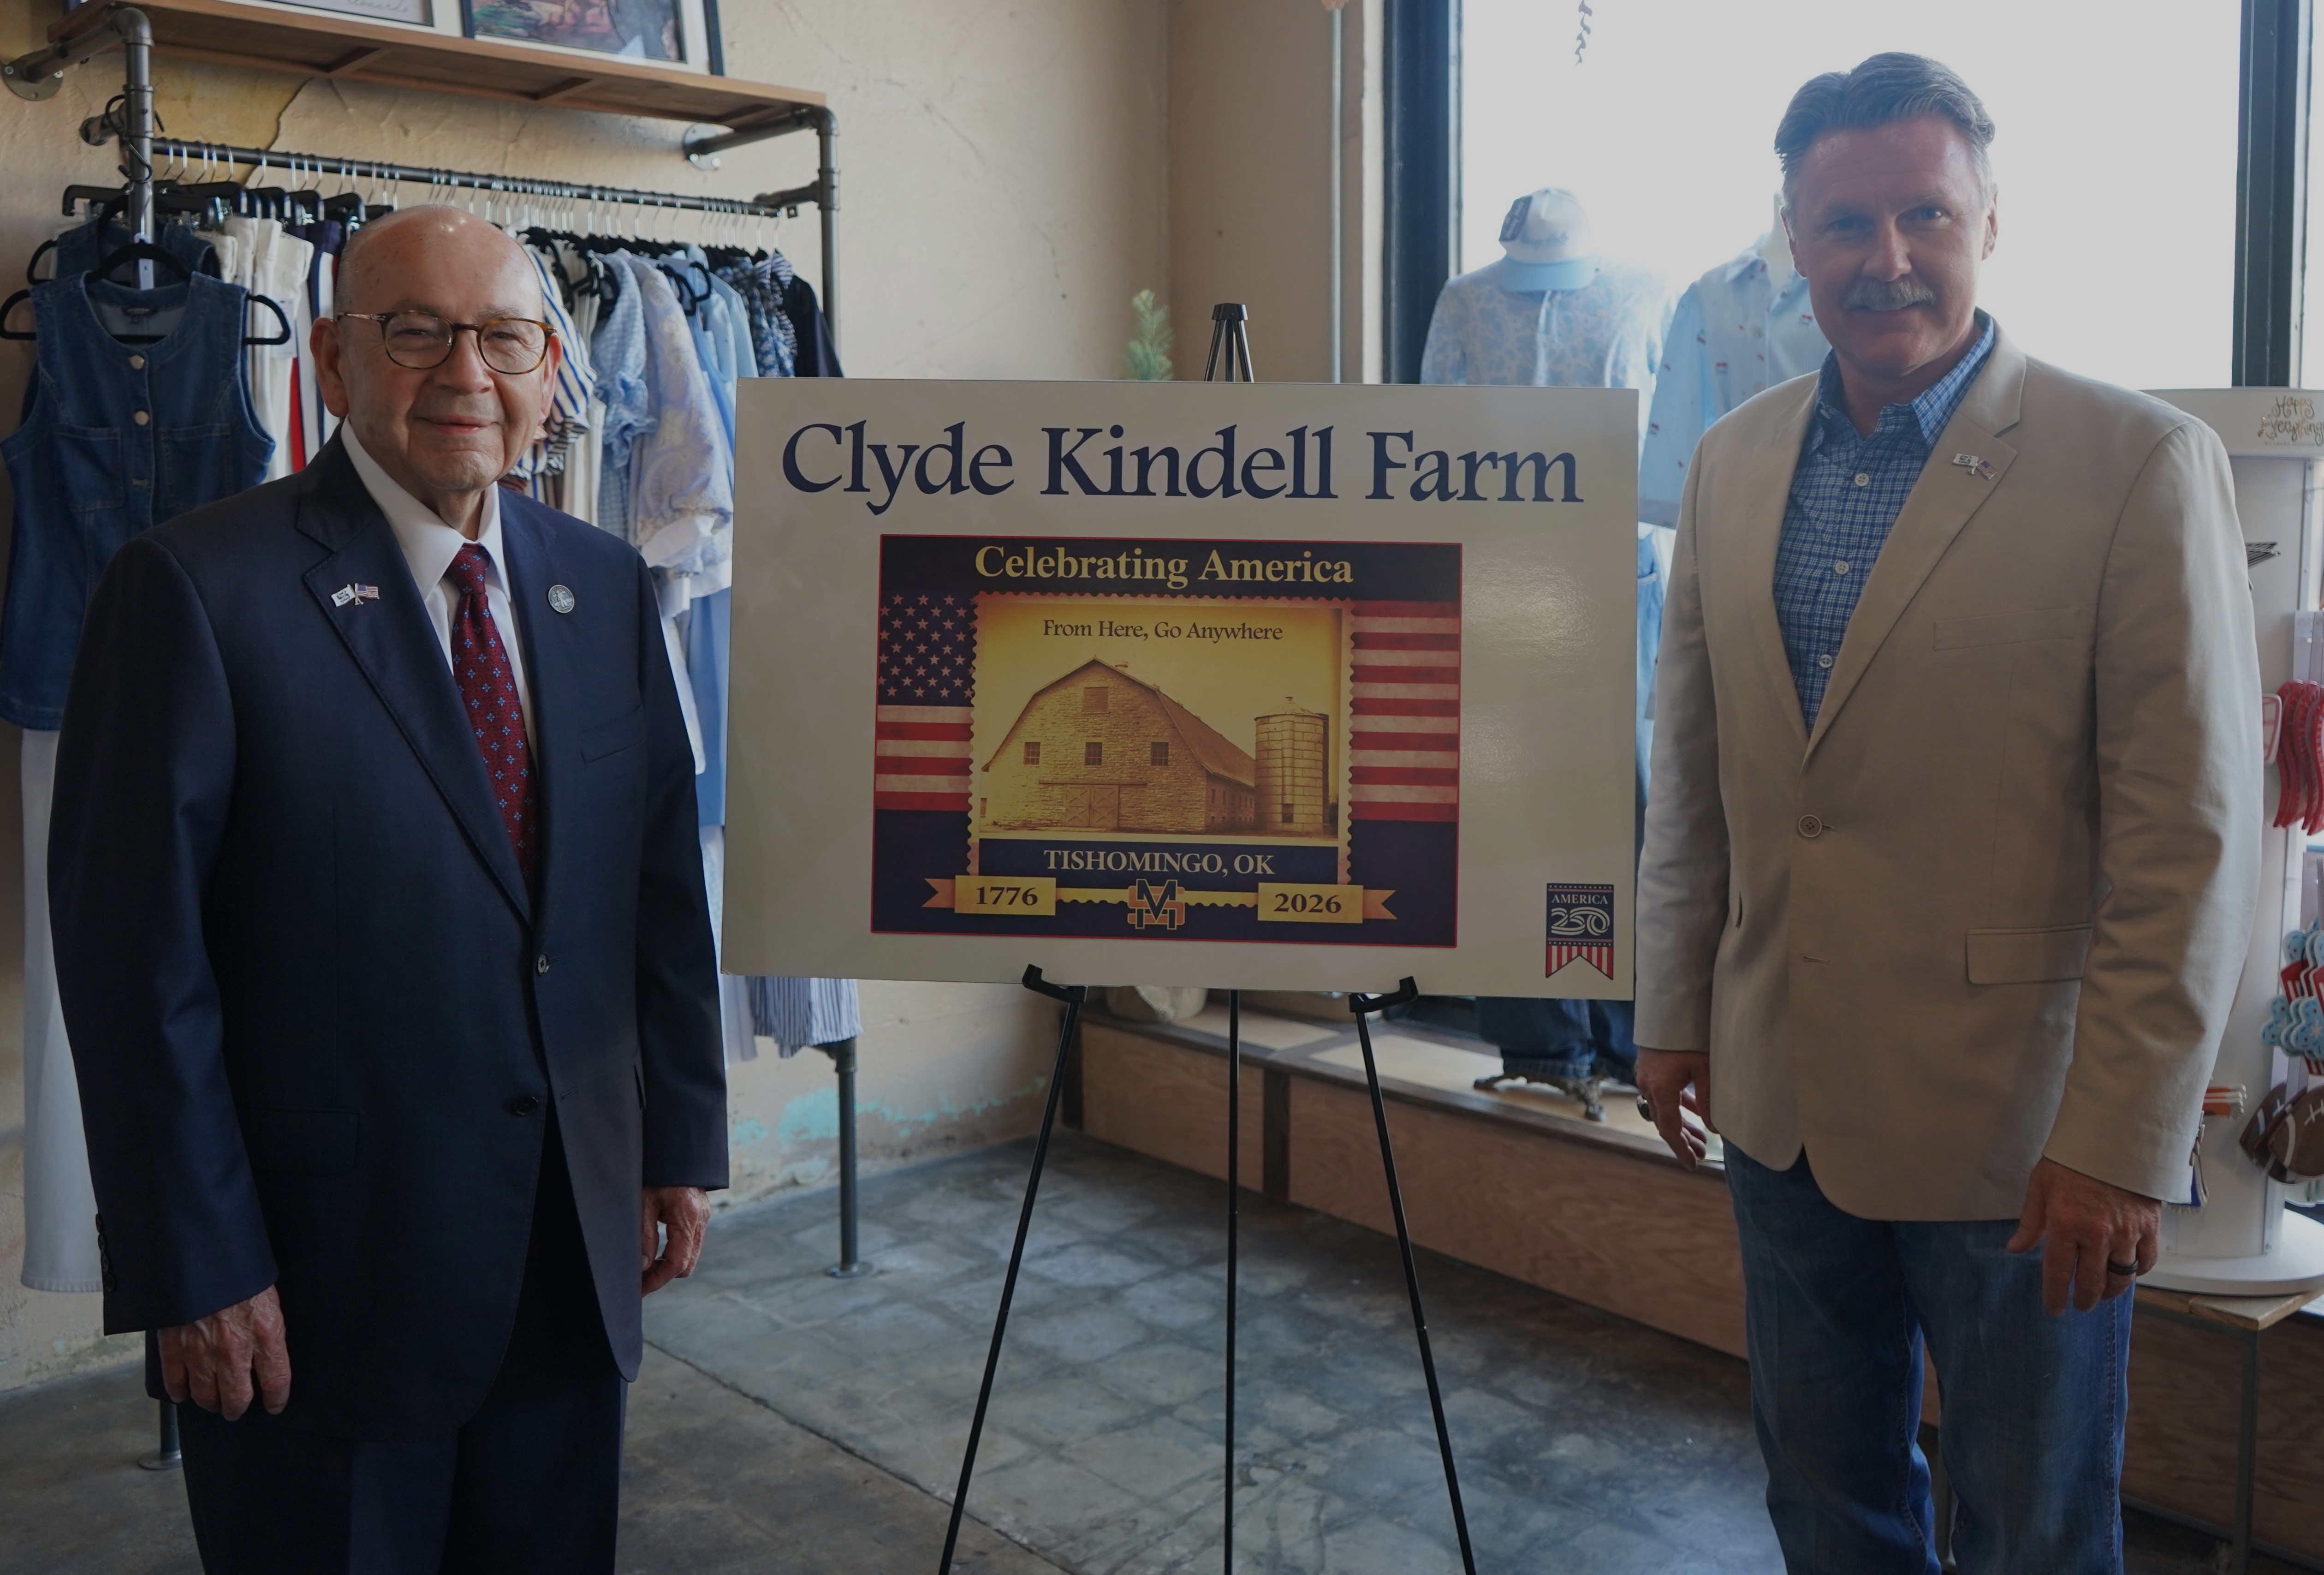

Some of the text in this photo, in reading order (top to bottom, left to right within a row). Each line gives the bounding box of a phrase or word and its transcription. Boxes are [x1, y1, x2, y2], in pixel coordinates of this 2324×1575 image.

[2258, 414, 2324, 447] Everything
[783, 420, 1584, 516] Clyde Kindell Farm
[975, 546, 1354, 590] Celebrating America
[1043, 620, 1283, 644] From Here, Go Anywhere
[1044, 850, 1275, 877] TISHOMINGO, OK
[976, 886, 1038, 907] 1776
[1274, 893, 1342, 914] 2026
[1551, 894, 1608, 905] AMERICA
[1551, 907, 1610, 936] 250
